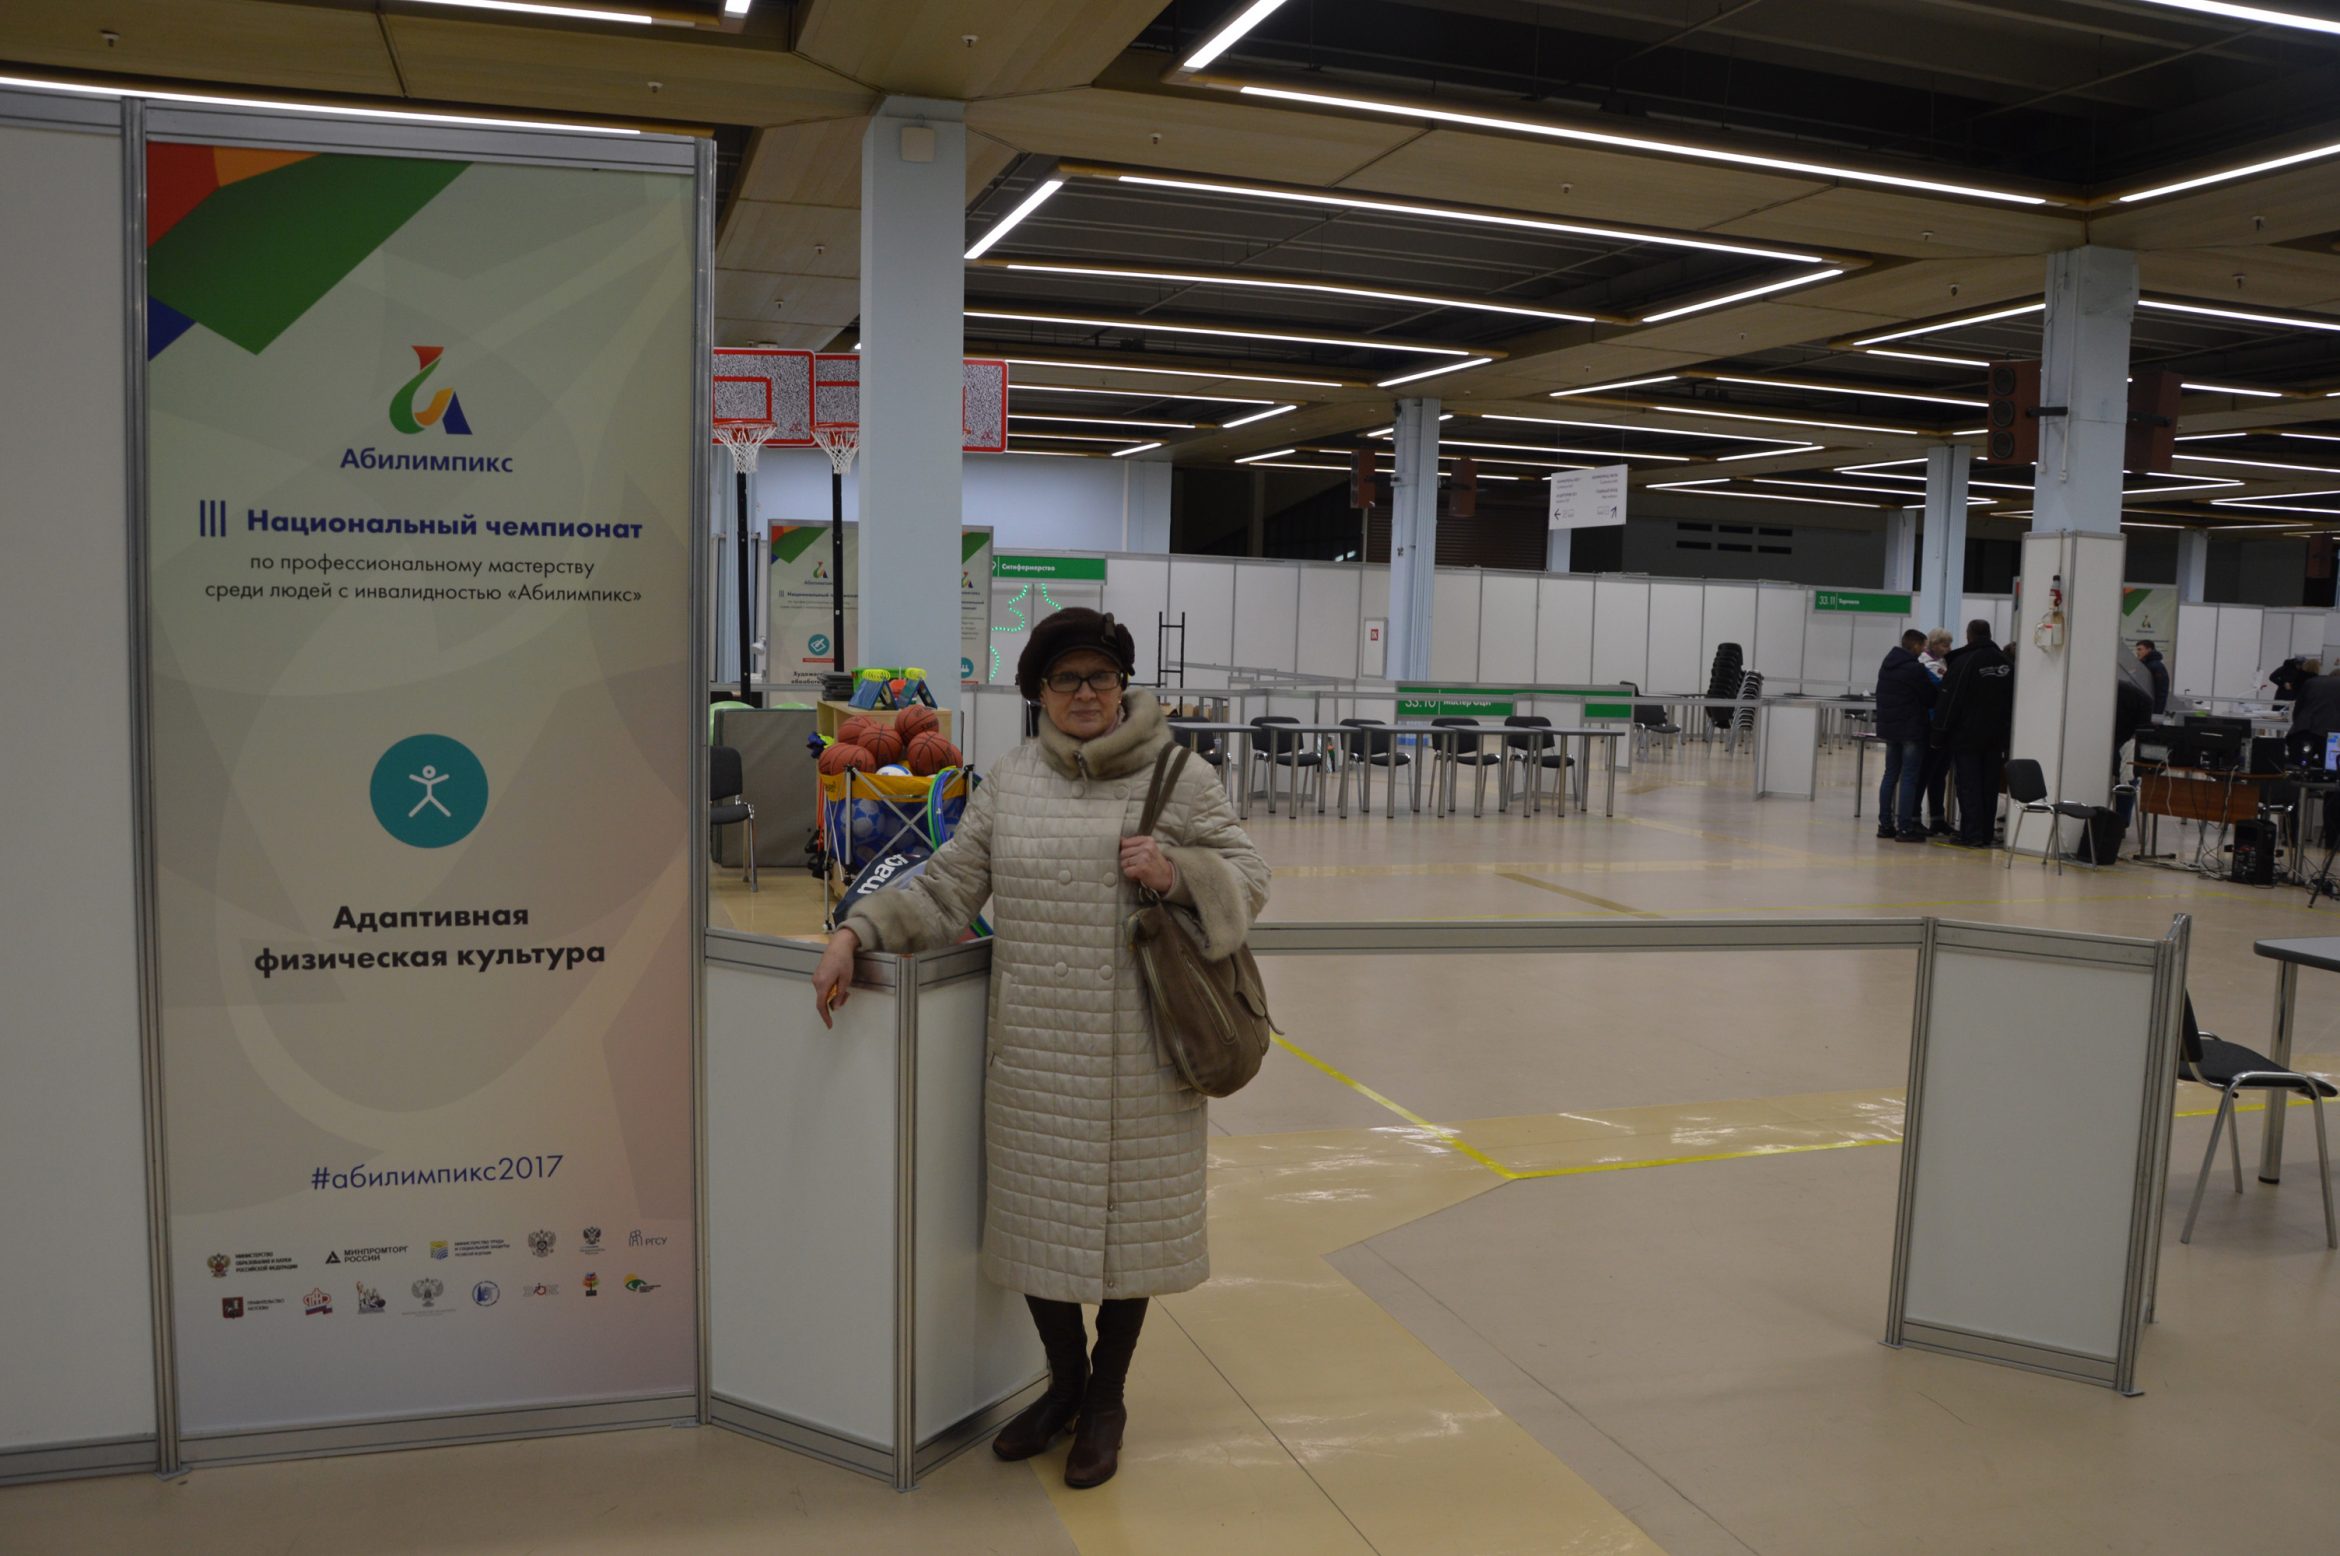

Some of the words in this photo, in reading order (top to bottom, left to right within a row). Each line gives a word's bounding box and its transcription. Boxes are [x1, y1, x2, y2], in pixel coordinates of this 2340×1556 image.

[340, 447, 514, 474] Абилимпикс
[247, 509, 477, 536] Национальный
[486, 517, 644, 540] чемпионат
[250, 557, 275, 571] по
[281, 554, 483, 578] профессиональному
[489, 561, 595, 579] мастерству
[205, 582, 264, 603] среди
[269, 582, 333, 602] людей
[338, 587, 349, 600] с
[355, 583, 503, 603] инвалидностью
[508, 579, 642, 604] «Абилимпикс»
[333, 904, 529, 934] Адаптивная
[253, 947, 448, 979] физическая
[457, 942, 606, 973] культура
[311, 1154, 564, 1191] #абилимпикс2017
[344, 1246, 408, 1256] МИНПРОМТОРГ
[645, 1236, 668, 1246] РГСУ
[344, 1255, 380, 1263] РОССИИ
